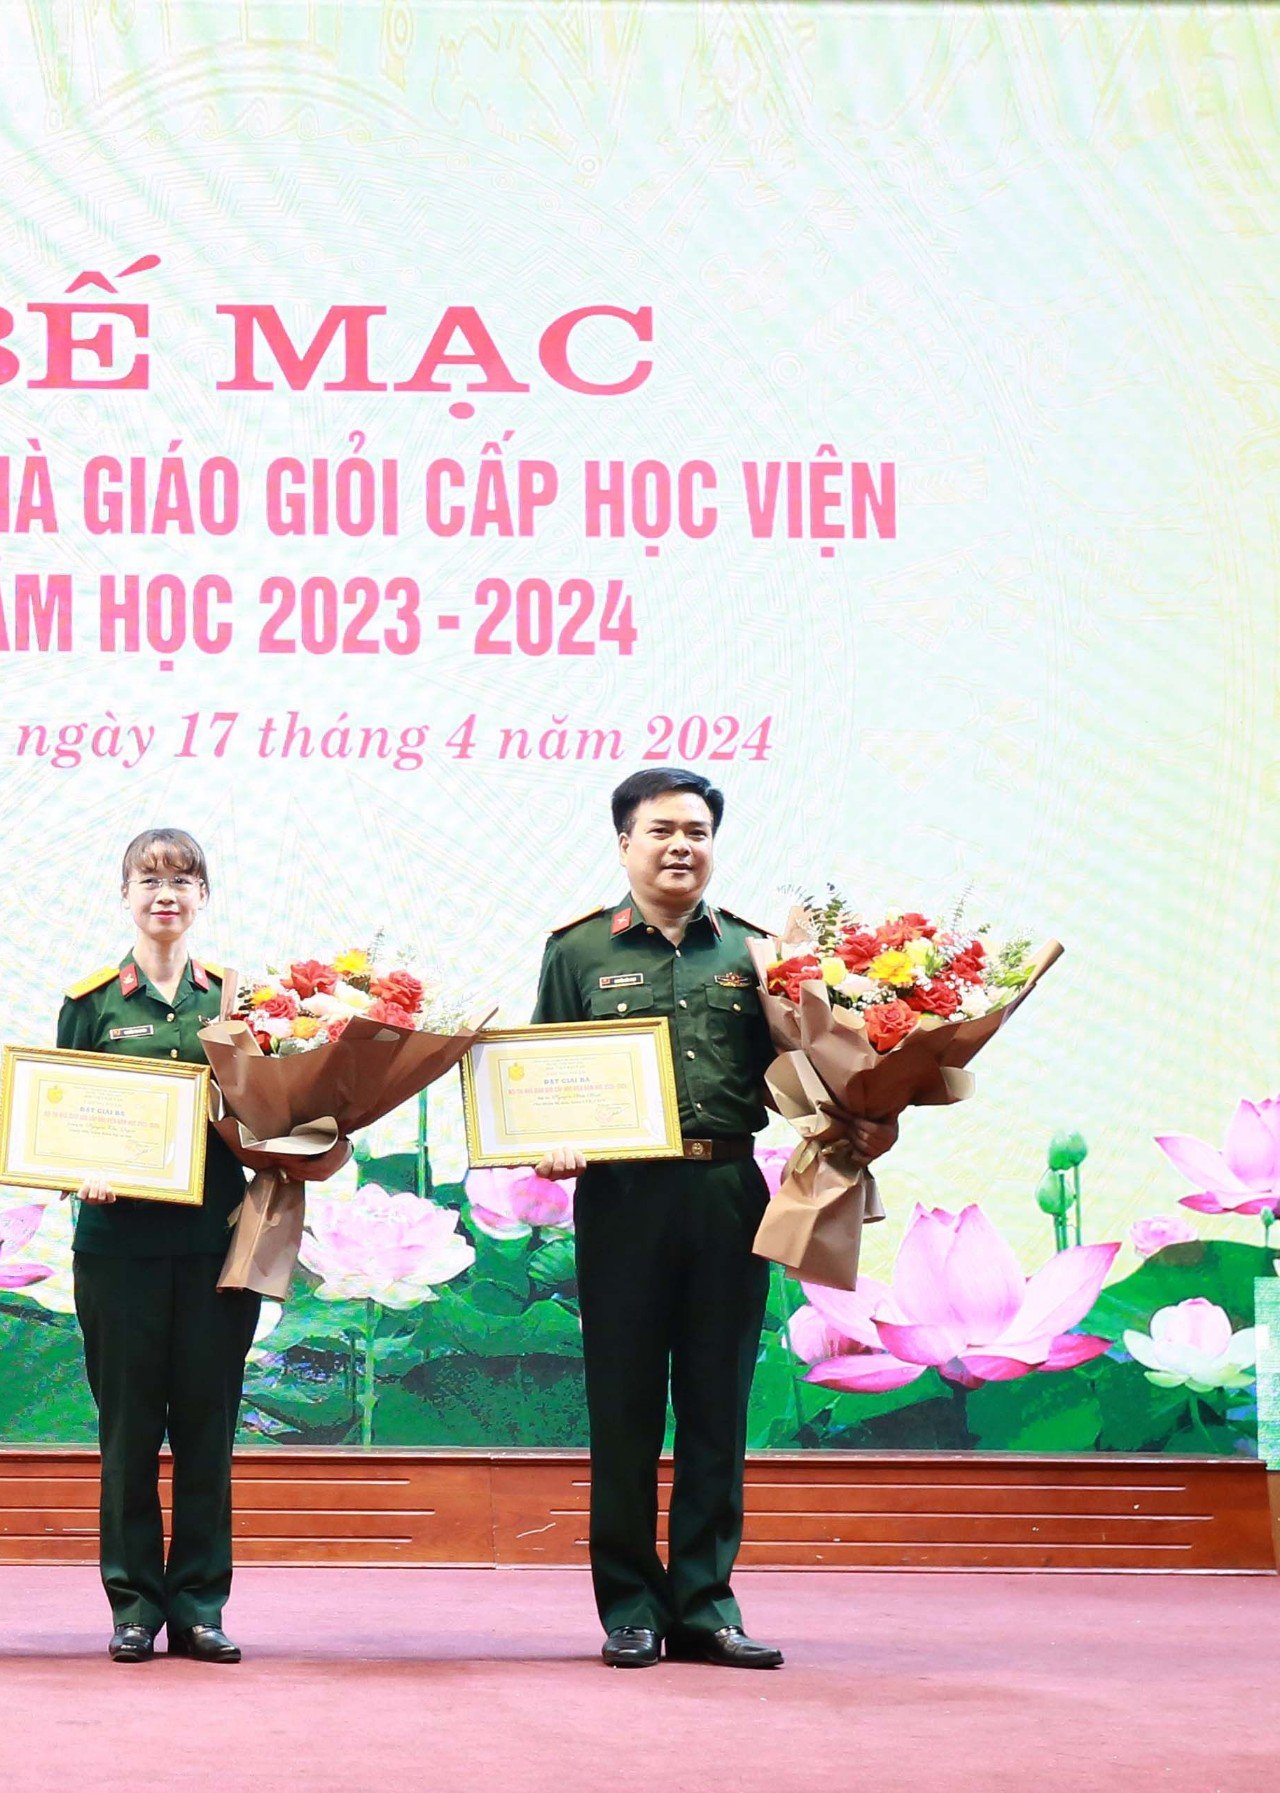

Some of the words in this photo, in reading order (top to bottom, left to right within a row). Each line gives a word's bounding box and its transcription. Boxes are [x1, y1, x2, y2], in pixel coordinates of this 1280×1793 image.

[215, 304, 654, 420] MẠC
[83, 439, 240, 537] GIÁO
[266, 430, 399, 538] GIỎI
[425, 430, 559, 540] CẤP
[585, 459, 718, 557] HỌC
[742, 443, 898, 559] VIỆN
[100, 574, 234, 672] HỌC
[259, 576, 422, 656] 2023
[438, 615, 460, 630] -
[474, 577, 638, 657] 2024
[17, 709, 156, 769] ngày
[177, 712, 240, 759] 17
[258, 710, 431, 771] tháng
[445, 713, 478, 760] 4
[498, 714, 625, 761] năm
[641, 714, 774, 762] 2024
